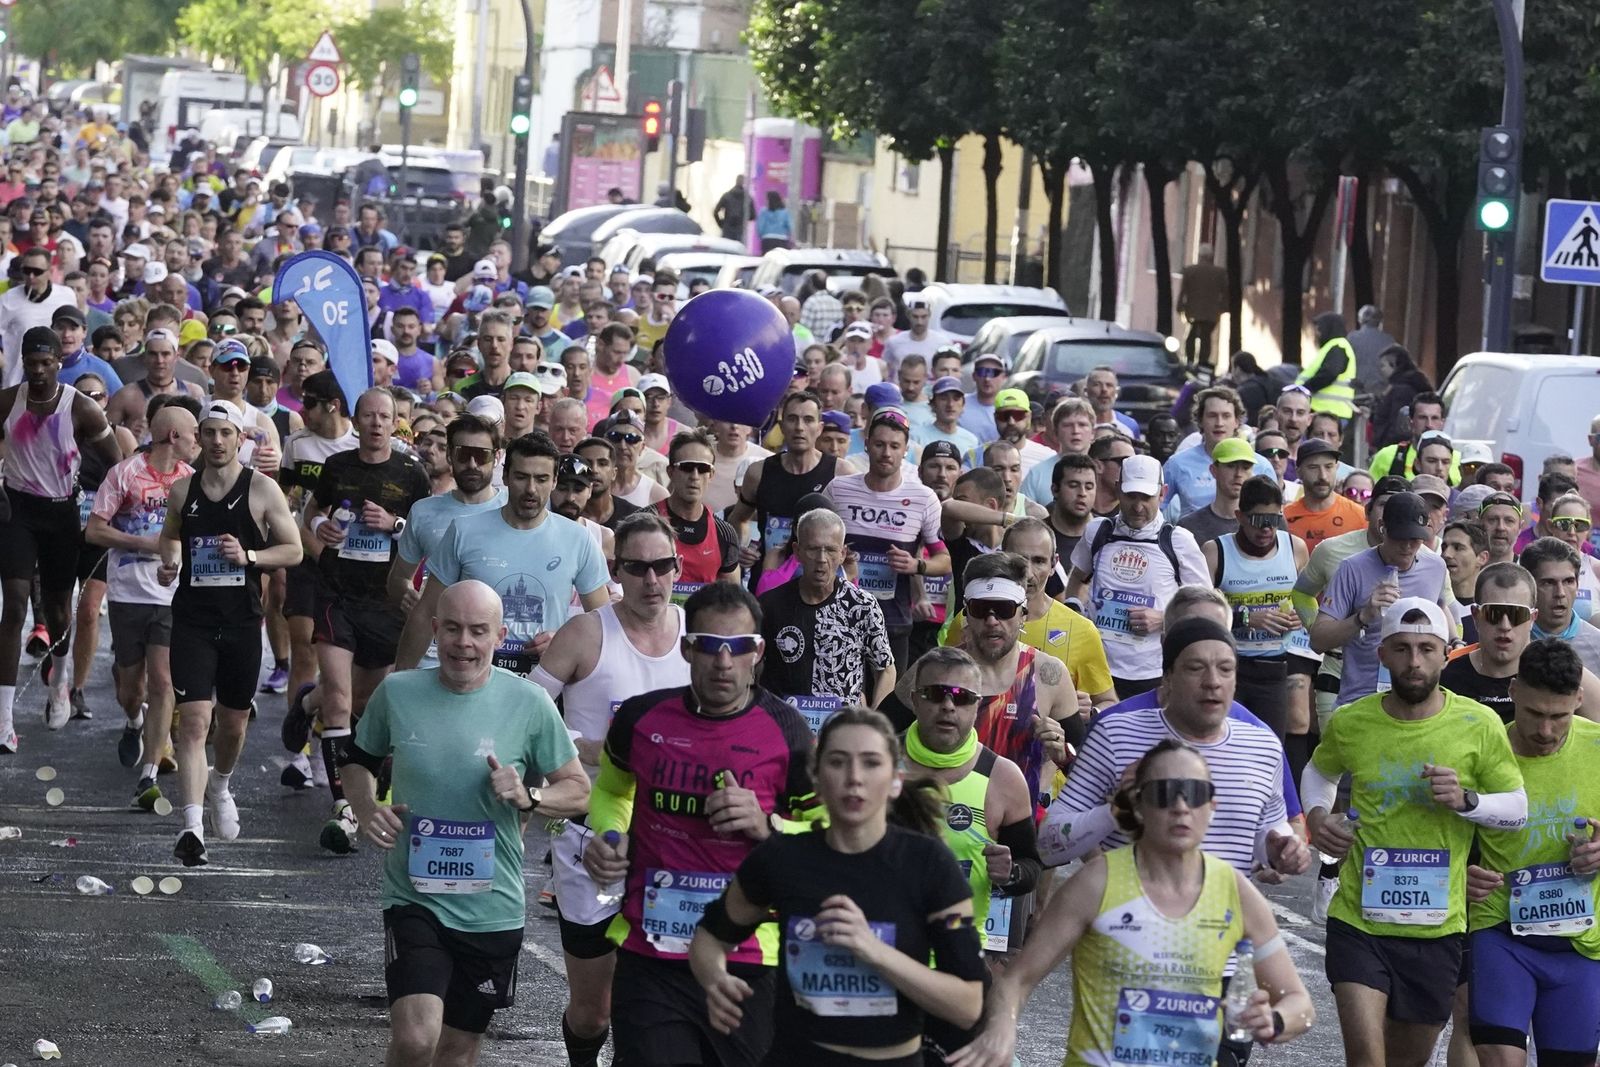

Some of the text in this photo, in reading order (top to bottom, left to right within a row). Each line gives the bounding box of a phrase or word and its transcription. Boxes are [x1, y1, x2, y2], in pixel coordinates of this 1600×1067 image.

[313, 74, 335, 86] 30
[718, 347, 765, 393] 3:30
[847, 504, 908, 527] TOAC
[193, 563, 226, 574] GUILLE
[1265, 574, 1289, 582] CURVA
[1116, 592, 1149, 605] ZURICH
[498, 658, 518, 668] 5110
[801, 699, 837, 709] ZURICH
[439, 824, 486, 836] ZURICH
[439, 846, 465, 857] 7687
[1393, 852, 1440, 863] ZURICH
[427, 860, 475, 877] CHRIS
[1394, 875, 1419, 886] 8379
[1381, 890, 1431, 906] COSTA
[1538, 888, 1564, 900] 8380
[1518, 897, 1587, 921] CARRIÓN
[644, 918, 668, 933] FER
[801, 972, 881, 993] MARRIS
[1156, 997, 1210, 1015] ZURICH
[1113, 1045, 1214, 1067] CARMEN PEREA
